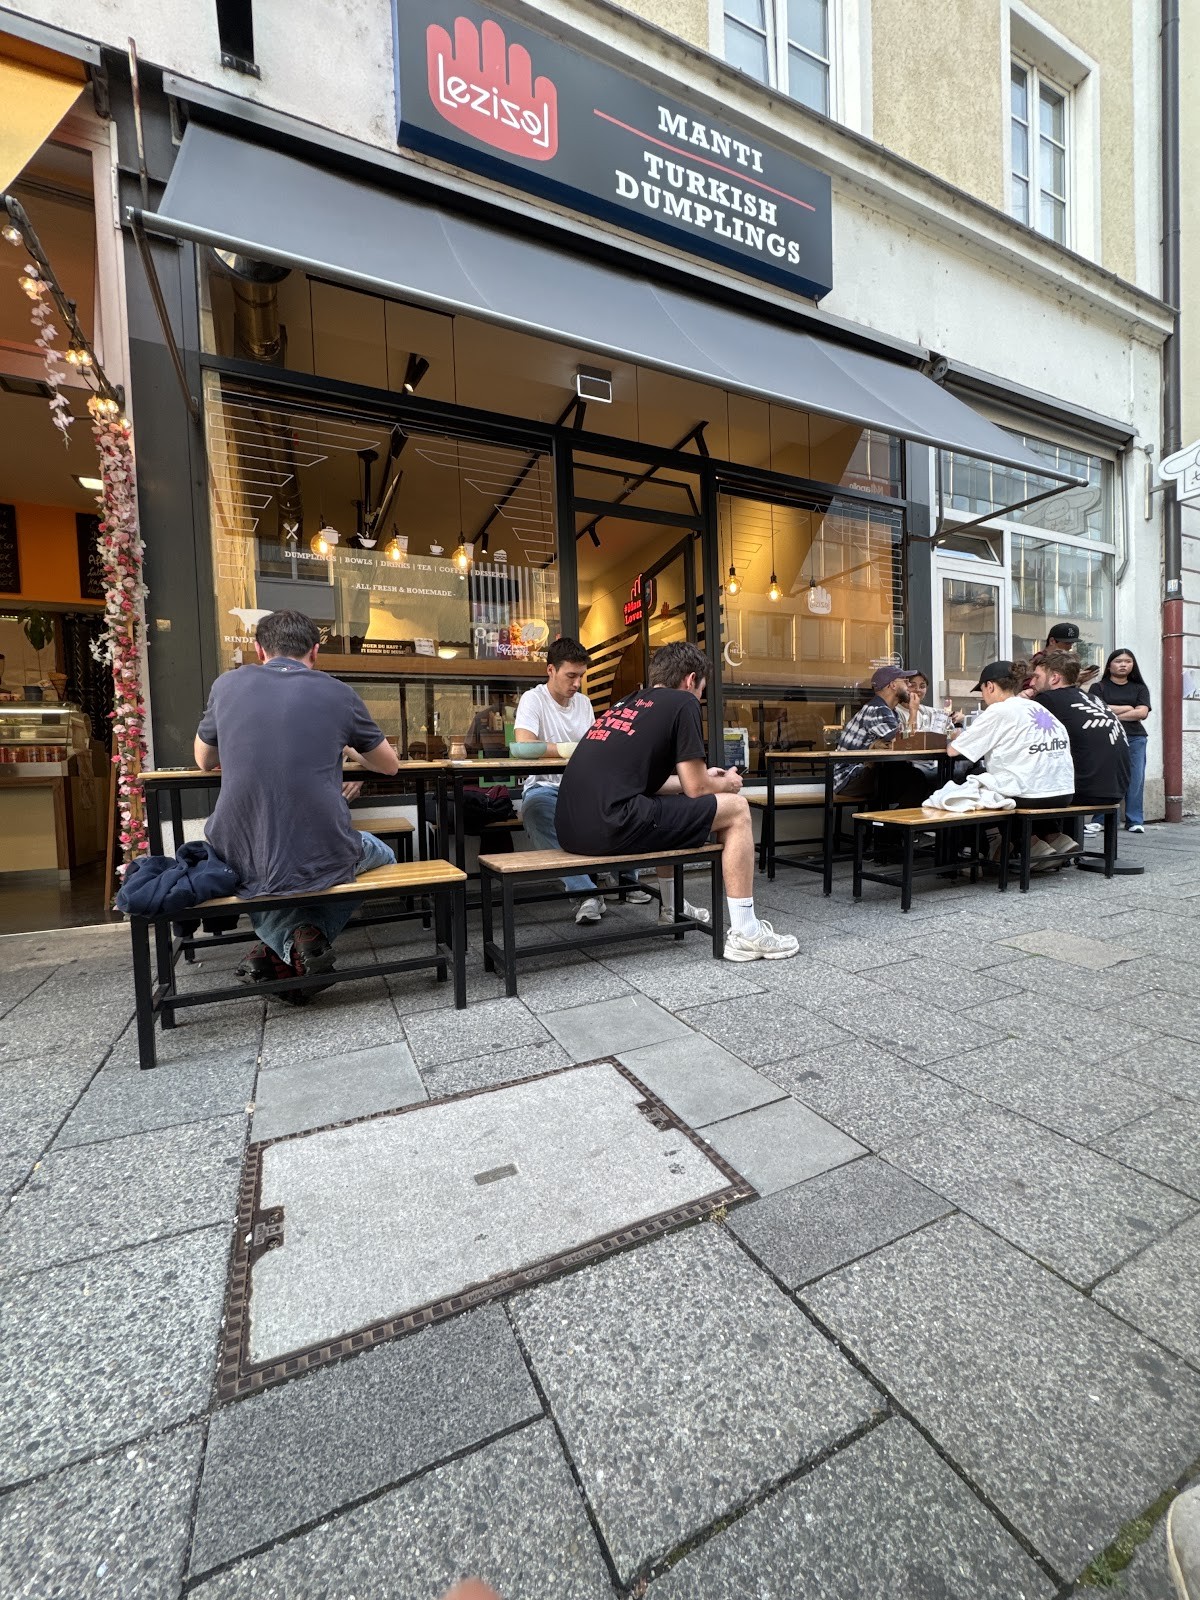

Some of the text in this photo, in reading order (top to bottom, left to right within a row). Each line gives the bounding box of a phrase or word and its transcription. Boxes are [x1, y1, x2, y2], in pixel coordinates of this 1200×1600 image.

[657, 105, 764, 174] MANTI
[643, 150, 778, 227] TURKISH
[615, 169, 800, 264] DUMPLINGS
[284, 550, 337, 562] DUMPLINGS
[344, 556, 373, 566] BOWLS
[380, 560, 411, 570] DRINKS
[439, 566, 468, 575] COFFEE
[475, 569, 509, 579] DESSERTS
[373, 584, 397, 592] FRESH
[406, 587, 452, 597] HOMEMADE
[223, 635, 256, 644] RINDF
[604, 716, 636, 736] YES,
